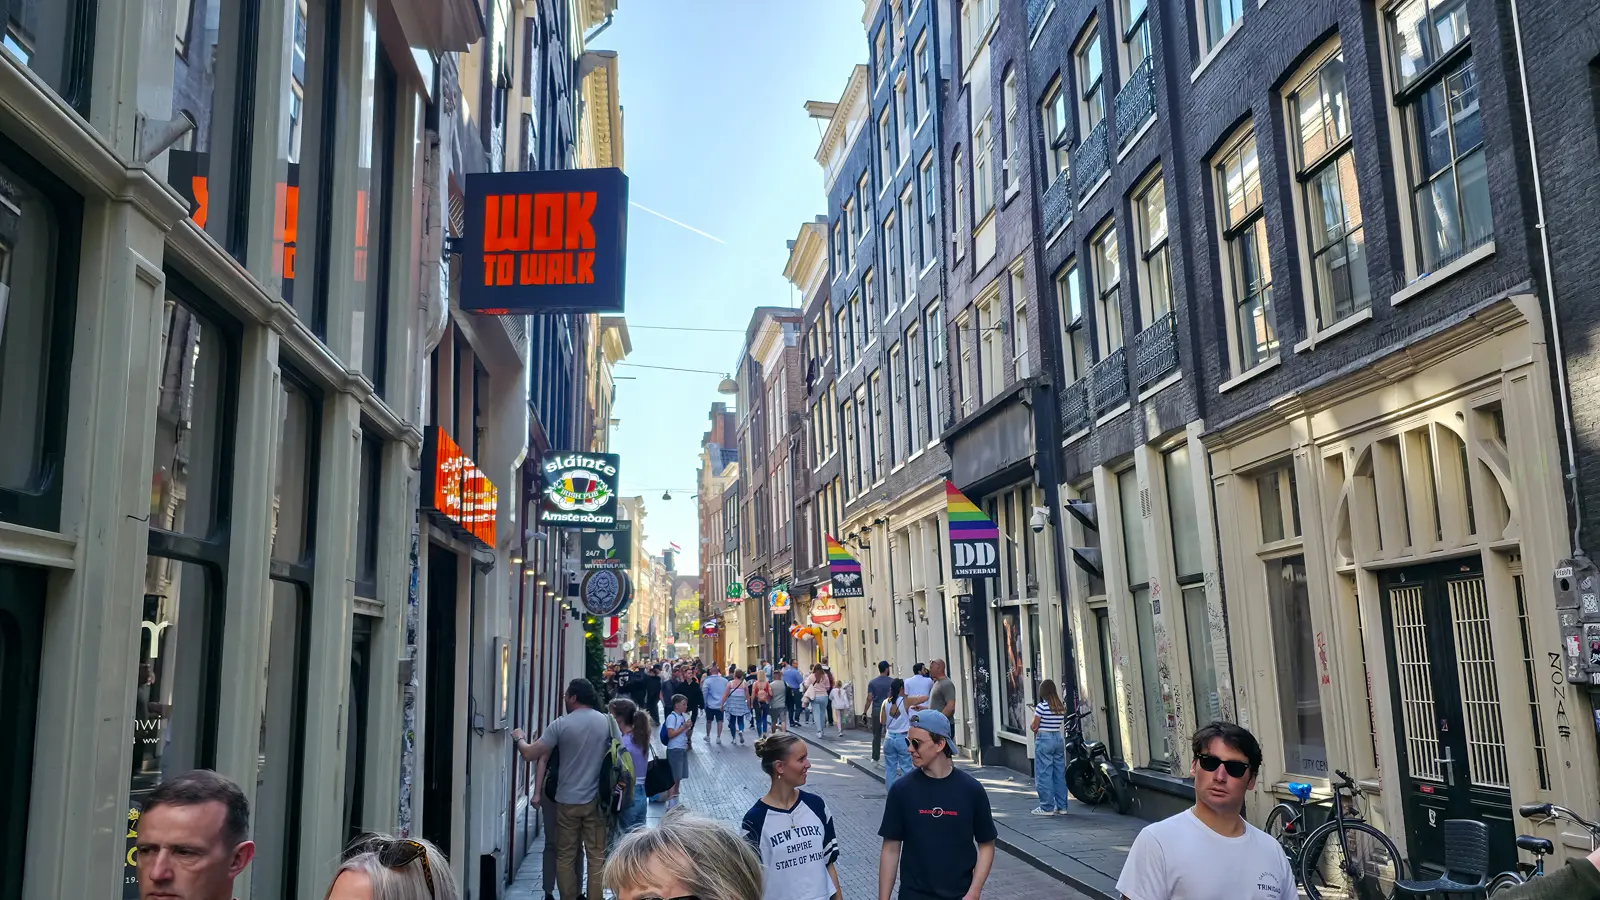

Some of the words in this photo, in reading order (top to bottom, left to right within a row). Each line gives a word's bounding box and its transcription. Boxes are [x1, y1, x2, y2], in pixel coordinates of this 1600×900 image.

[484, 191, 597, 252] WOK
[484, 254, 514, 286] TO
[520, 252, 595, 285] WALK
[542, 511, 613, 523] Amsterdam
[953, 542, 996, 567] DD
[769, 829, 792, 848] NEW
[793, 825, 821, 838] YORK
[786, 840, 813, 854] EMPIRE
[775, 858, 798, 871] STATE
[798, 855, 808, 865] OF
